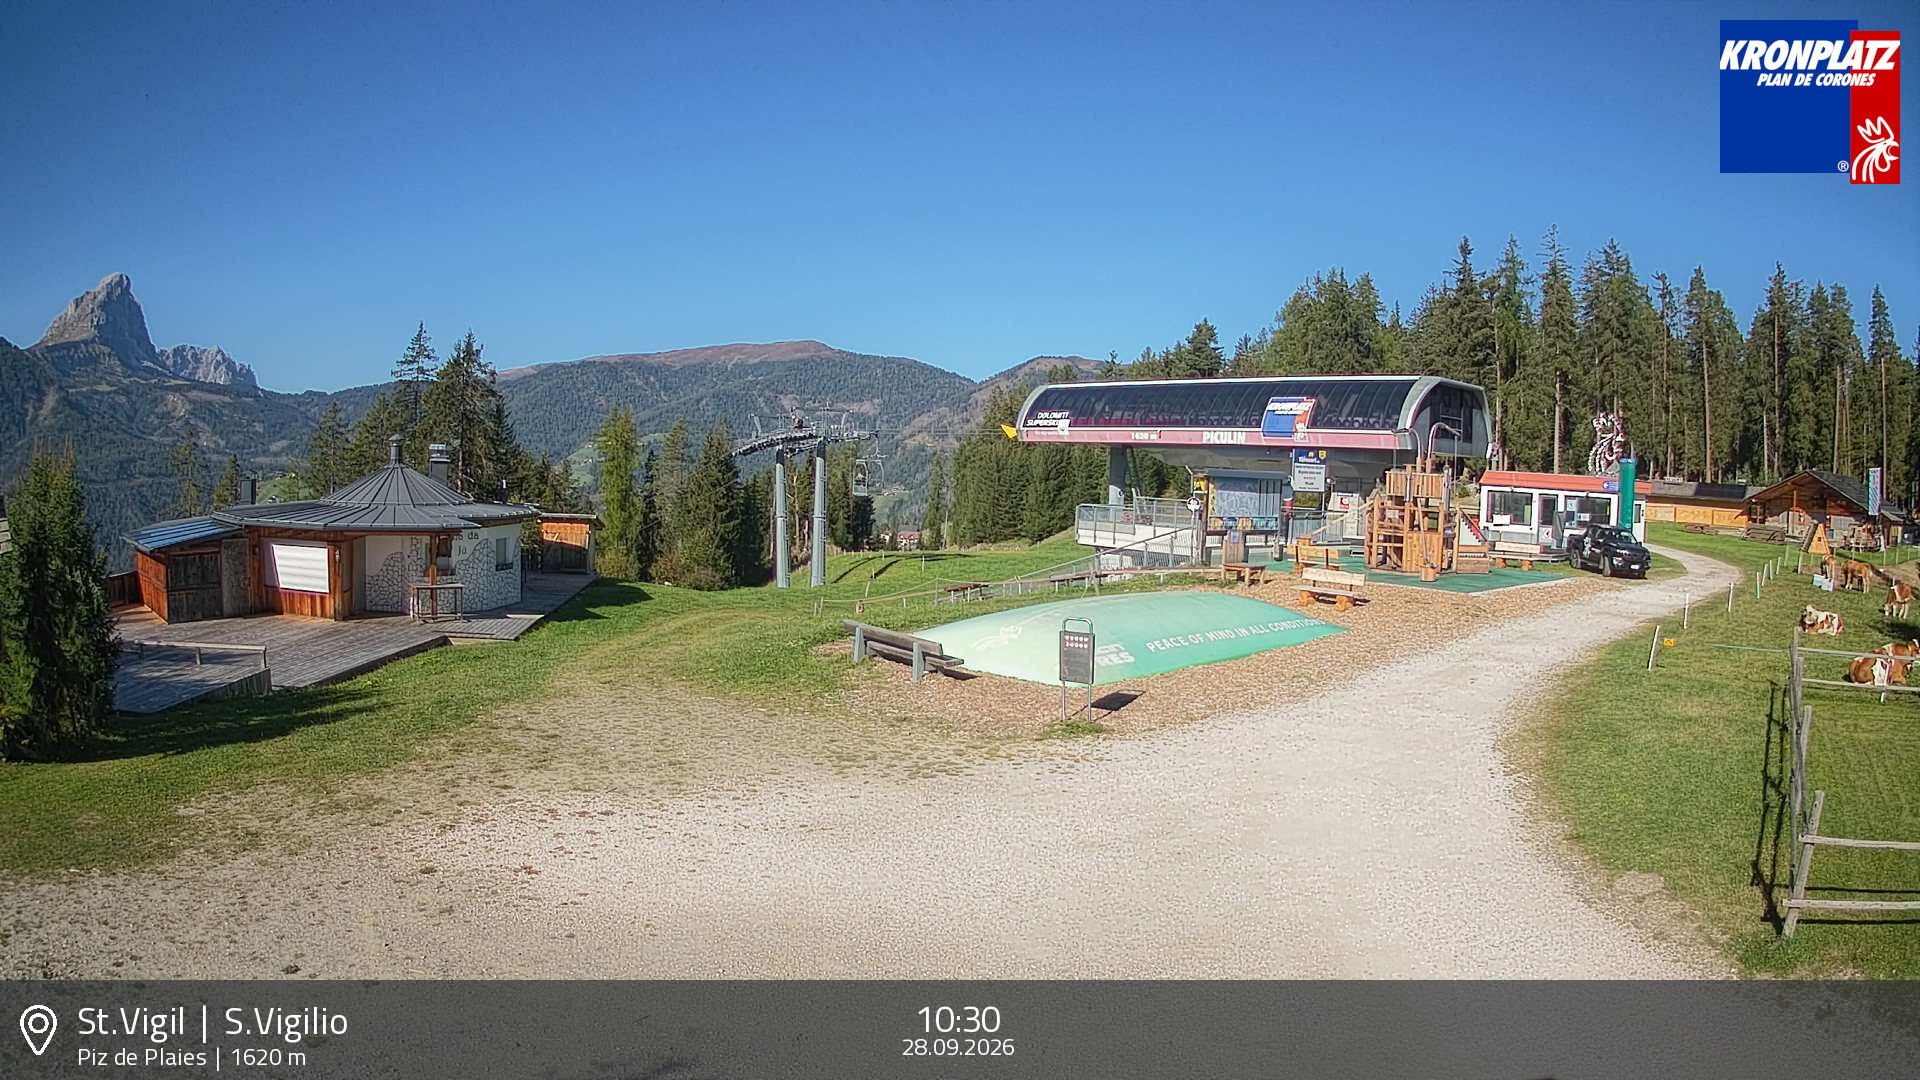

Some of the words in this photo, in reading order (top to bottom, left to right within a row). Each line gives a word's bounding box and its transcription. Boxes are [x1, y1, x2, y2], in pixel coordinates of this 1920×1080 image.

[1202, 431, 1246, 444] PICULIN
[1145, 636, 1189, 652] PEACE
[1190, 632, 1207, 644] OF
[1205, 628, 1236, 642] MIND
[1234, 626, 1250, 638] IN
[1250, 625, 1271, 636] ALL
